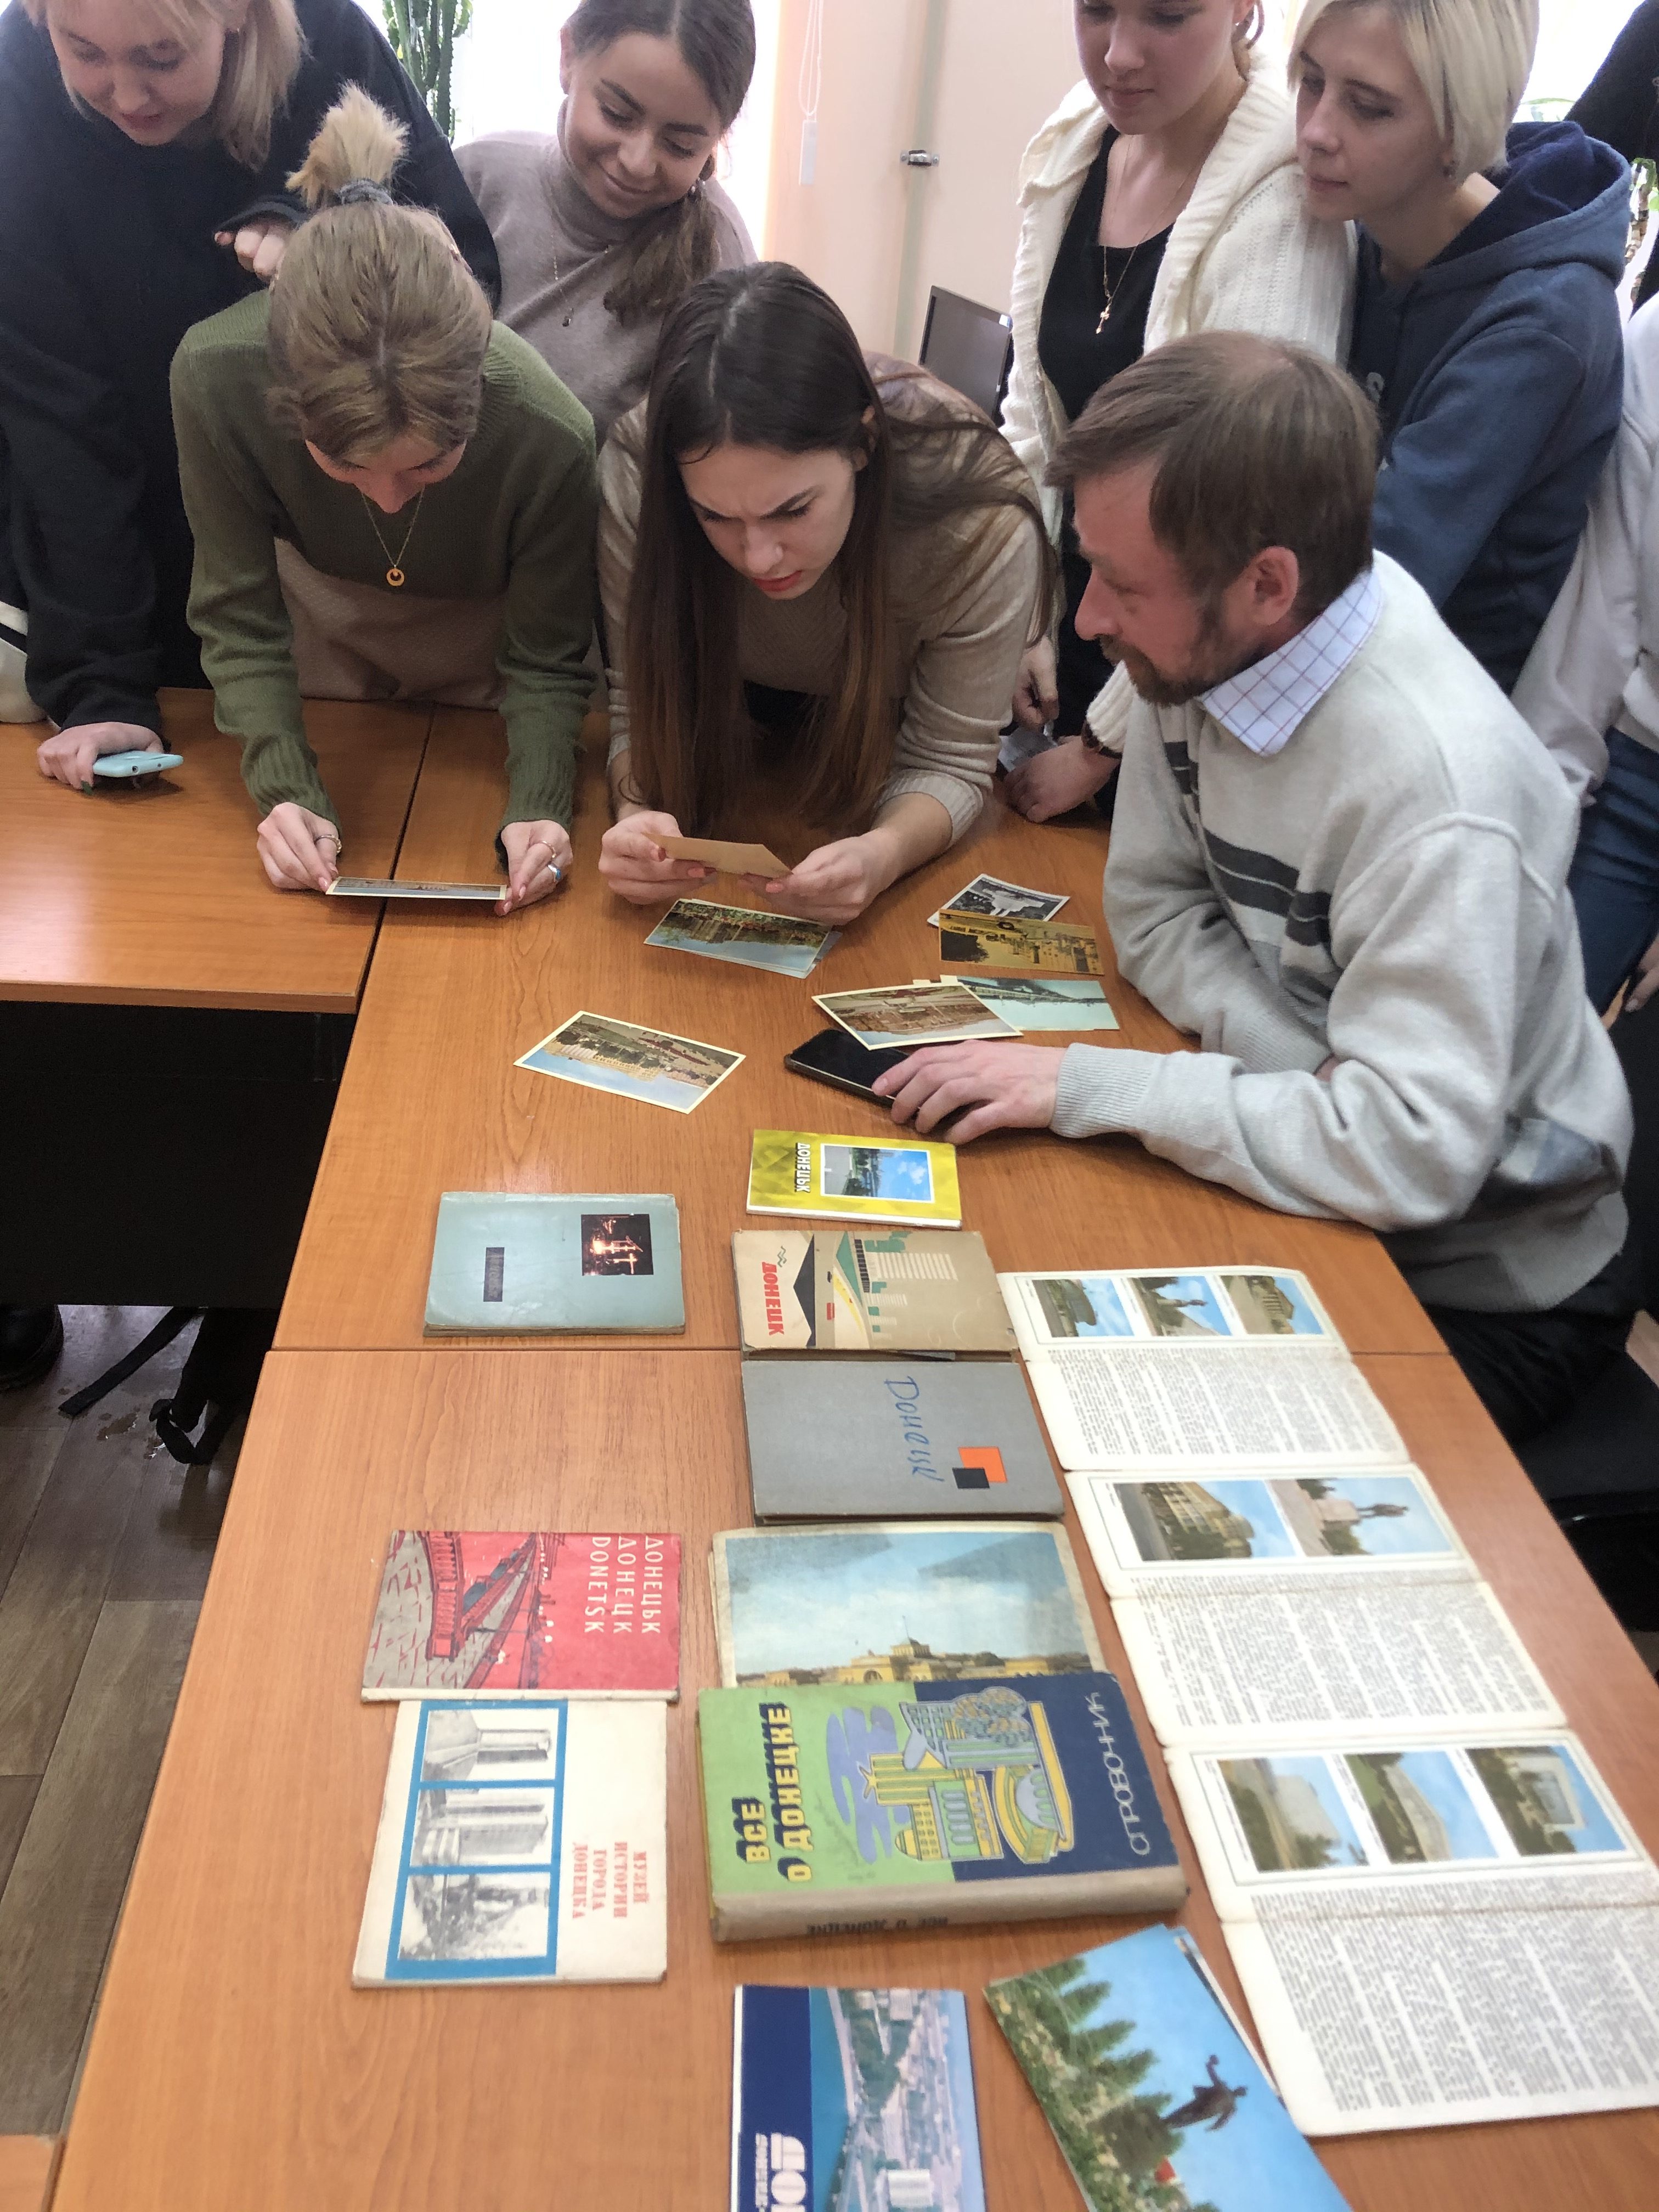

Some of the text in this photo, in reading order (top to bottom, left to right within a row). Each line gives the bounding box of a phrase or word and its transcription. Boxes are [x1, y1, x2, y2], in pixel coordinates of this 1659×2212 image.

[795, 1142, 811, 1193] ДОНЕЦЬК
[761, 1262, 785, 1335] ДОНЕЦК
[584, 1537, 612, 1633] DONETSK
[611, 1536, 637, 1633] ДОНЕЦК
[641, 1535, 664, 1633] ДОНЕЦЬК
[738, 1801, 771, 1863] ВСЕ
[765, 1705, 813, 1882] О ДОНЕЦКЕ
[572, 1841, 588, 1919] ДОНЕЦКА
[592, 1849, 607, 1911] ГОРОДА
[613, 1841, 628, 1918] ИСТОРИИ
[633, 1850, 650, 1904] МУЗЕЙ
